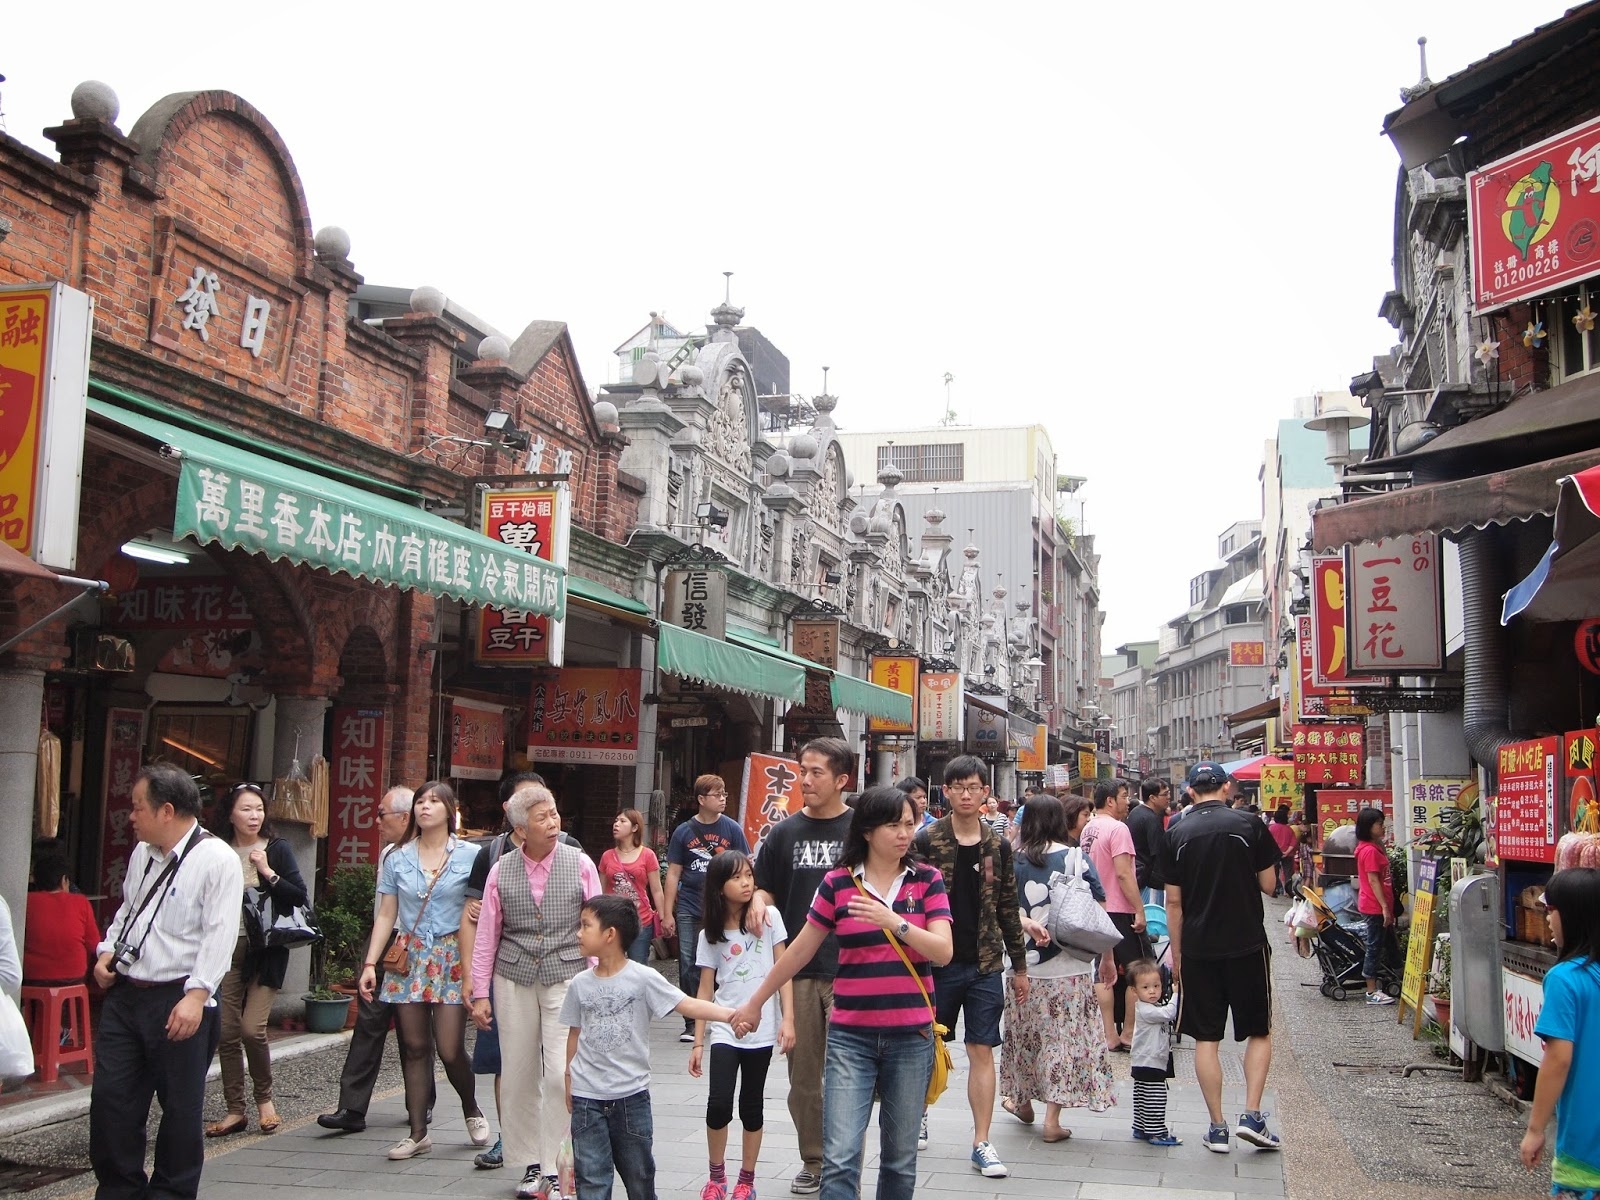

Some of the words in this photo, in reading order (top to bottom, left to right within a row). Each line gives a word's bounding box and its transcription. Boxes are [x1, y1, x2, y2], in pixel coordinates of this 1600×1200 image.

[1495, 255, 1559, 289] 01200226
[490, 501, 551, 518] 豆干始祖
[1362, 540, 1404, 660] 一豆花
[487, 629, 542, 650] 豆干
[1264, 769, 1290, 781] 冬瓜
[336, 715, 376, 870] 知味花生
[1321, 804, 1343, 813] 手工
